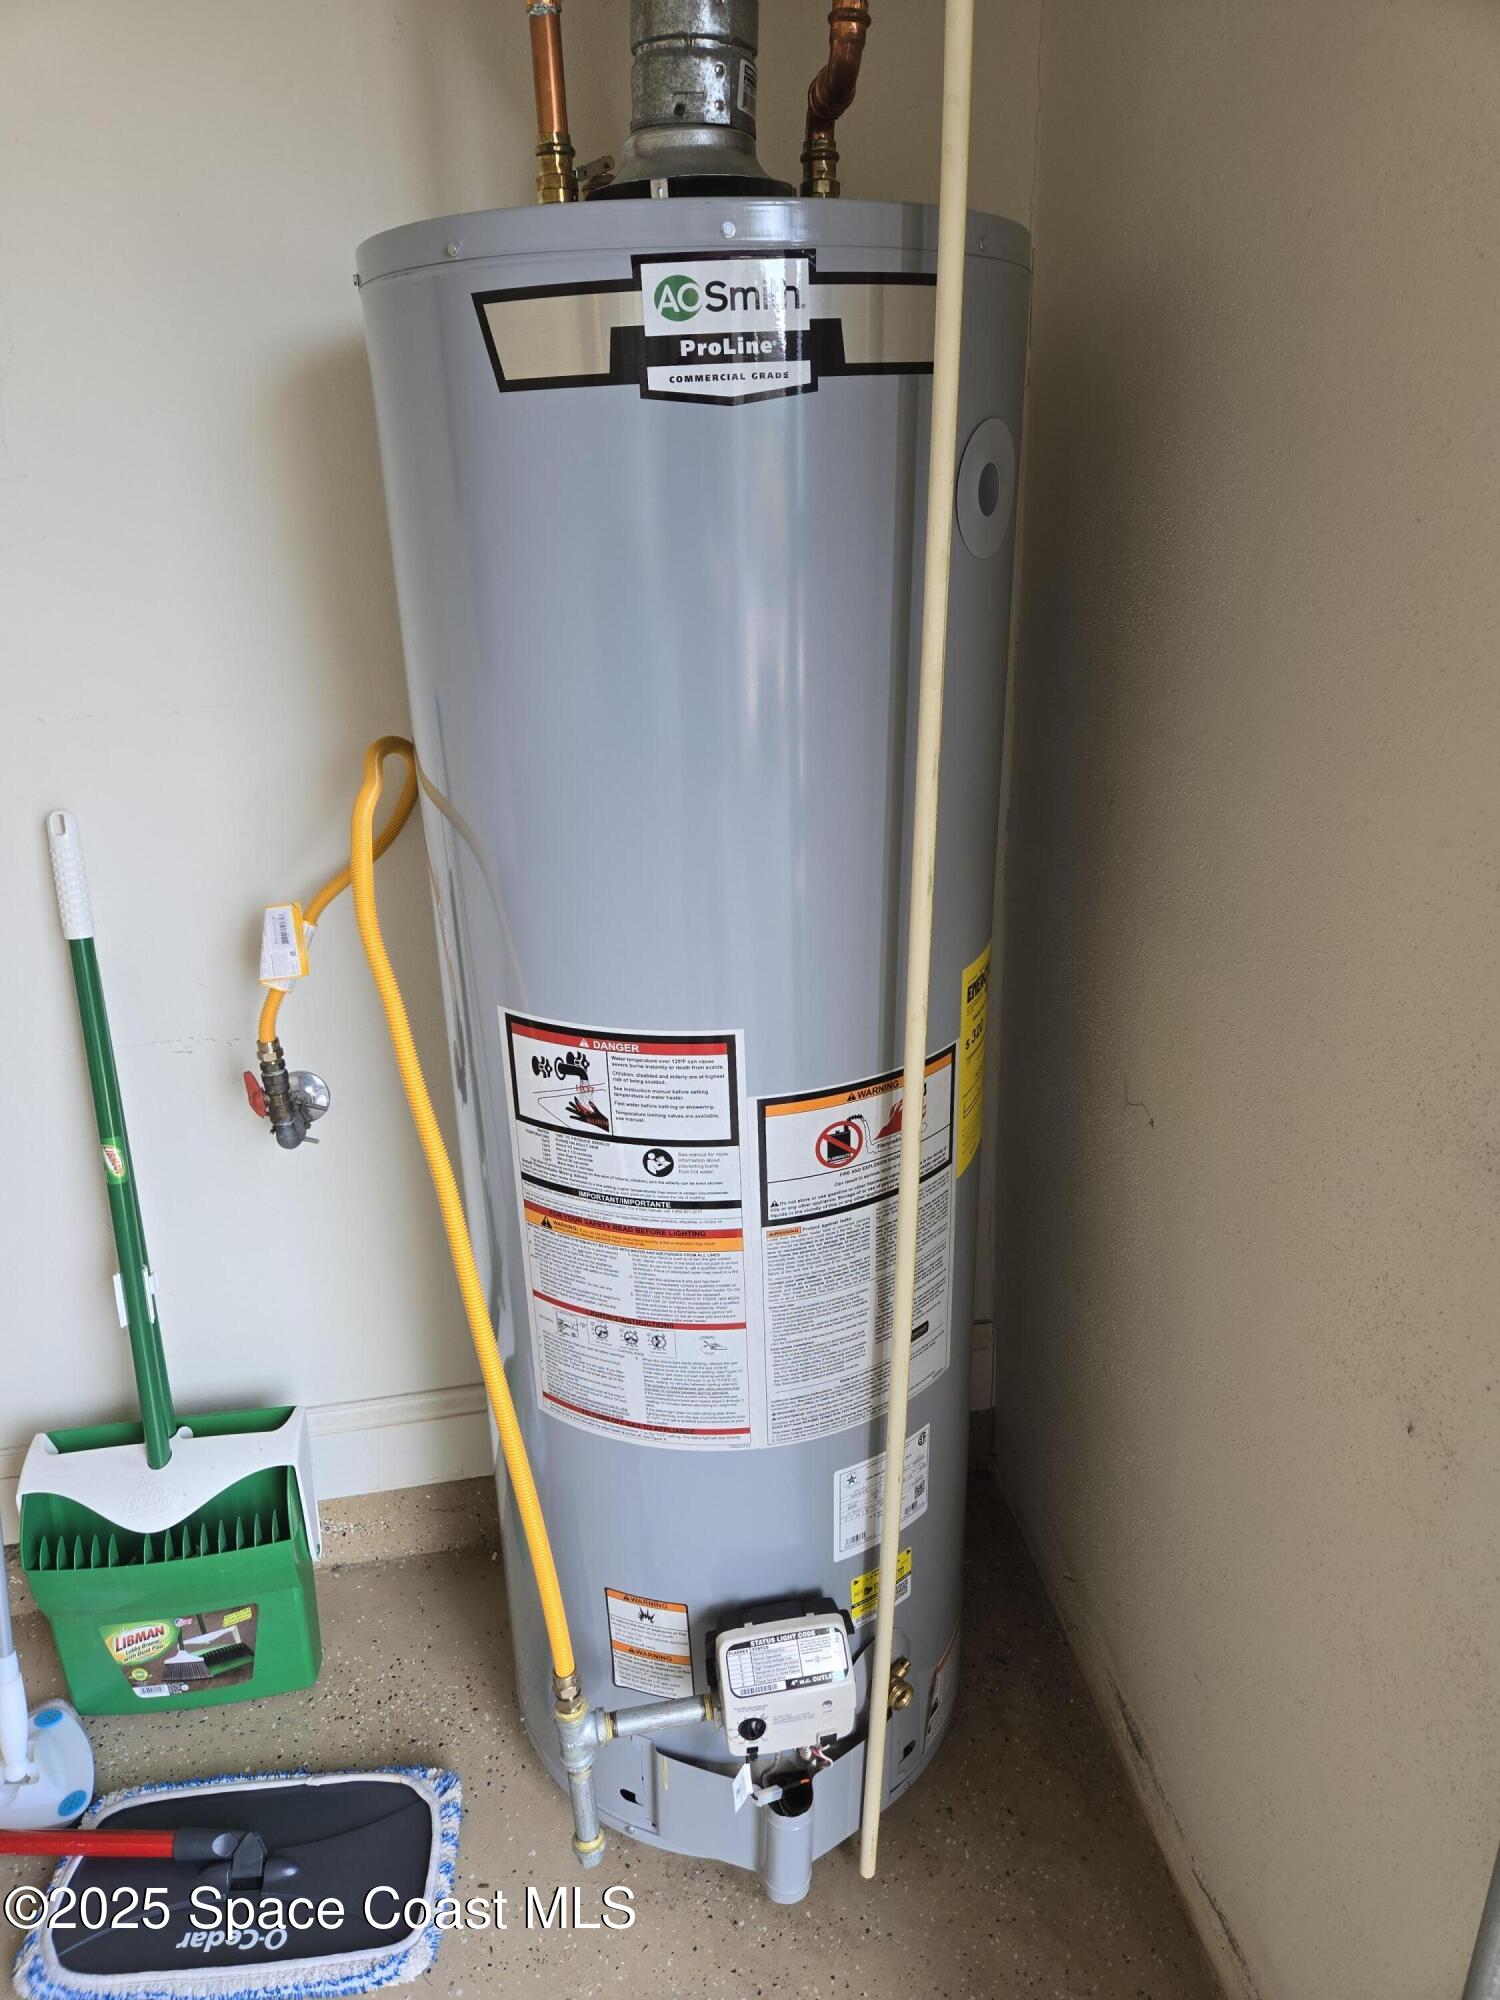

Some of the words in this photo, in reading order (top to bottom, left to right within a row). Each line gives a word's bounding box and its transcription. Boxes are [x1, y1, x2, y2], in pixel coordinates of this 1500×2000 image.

[680, 337, 772, 357] ProLine
[669, 373, 746, 383] COMMERCIAL
[751, 371, 790, 380] GRADE
[593, 1040, 640, 1053] DANGER
[857, 1080, 899, 1098] WARNING
[578, 1190, 671, 1208] IMPORTANT/IMPORTANTE
[564, 1214, 583, 1224] YOUR
[586, 1219, 611, 1230] SAFETY
[636, 1227, 667, 1236] BEFORE
[669, 1229, 706, 1237] LIGHTING
[630, 1596, 668, 1609] WARNING
[115, 1626, 165, 1652] LIBMAN
[750, 1637, 776, 1646] STATUS
[777, 1632, 797, 1642] LIGHT
[798, 1630, 816, 1638] CODE
[636, 1650, 672, 1662] WARNING
[812, 1672, 833, 1682] OUTLE
[176, 1927, 288, 1953] O-Cedar
